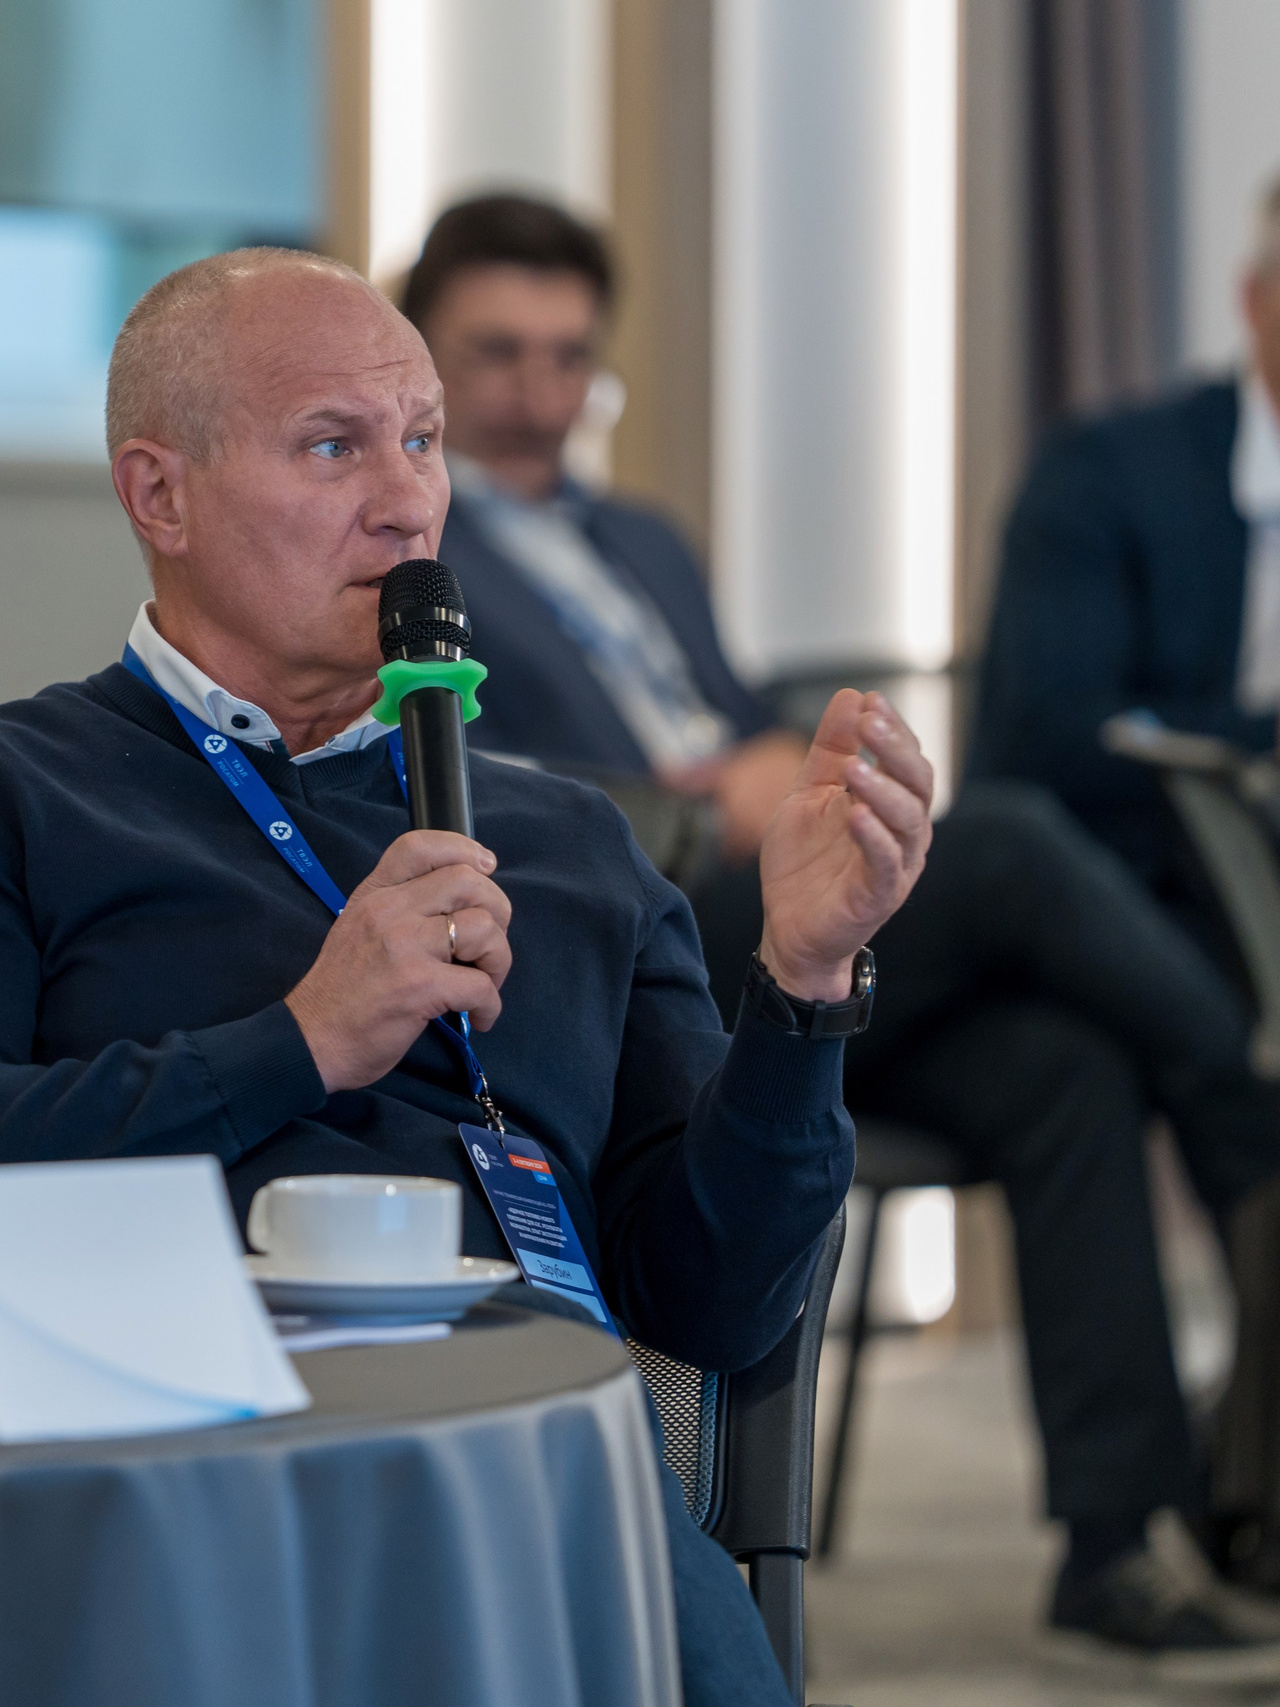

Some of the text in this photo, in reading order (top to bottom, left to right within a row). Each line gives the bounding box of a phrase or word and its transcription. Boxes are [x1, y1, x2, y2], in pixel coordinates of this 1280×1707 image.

[216, 760, 239, 787] РОСАТОМ
[231, 758, 249, 779] ТВЭЛ
[282, 847, 305, 873] РОСАТОМ
[296, 847, 313, 868] ТВЭЛ
[536, 1258, 572, 1282] Зарубин
